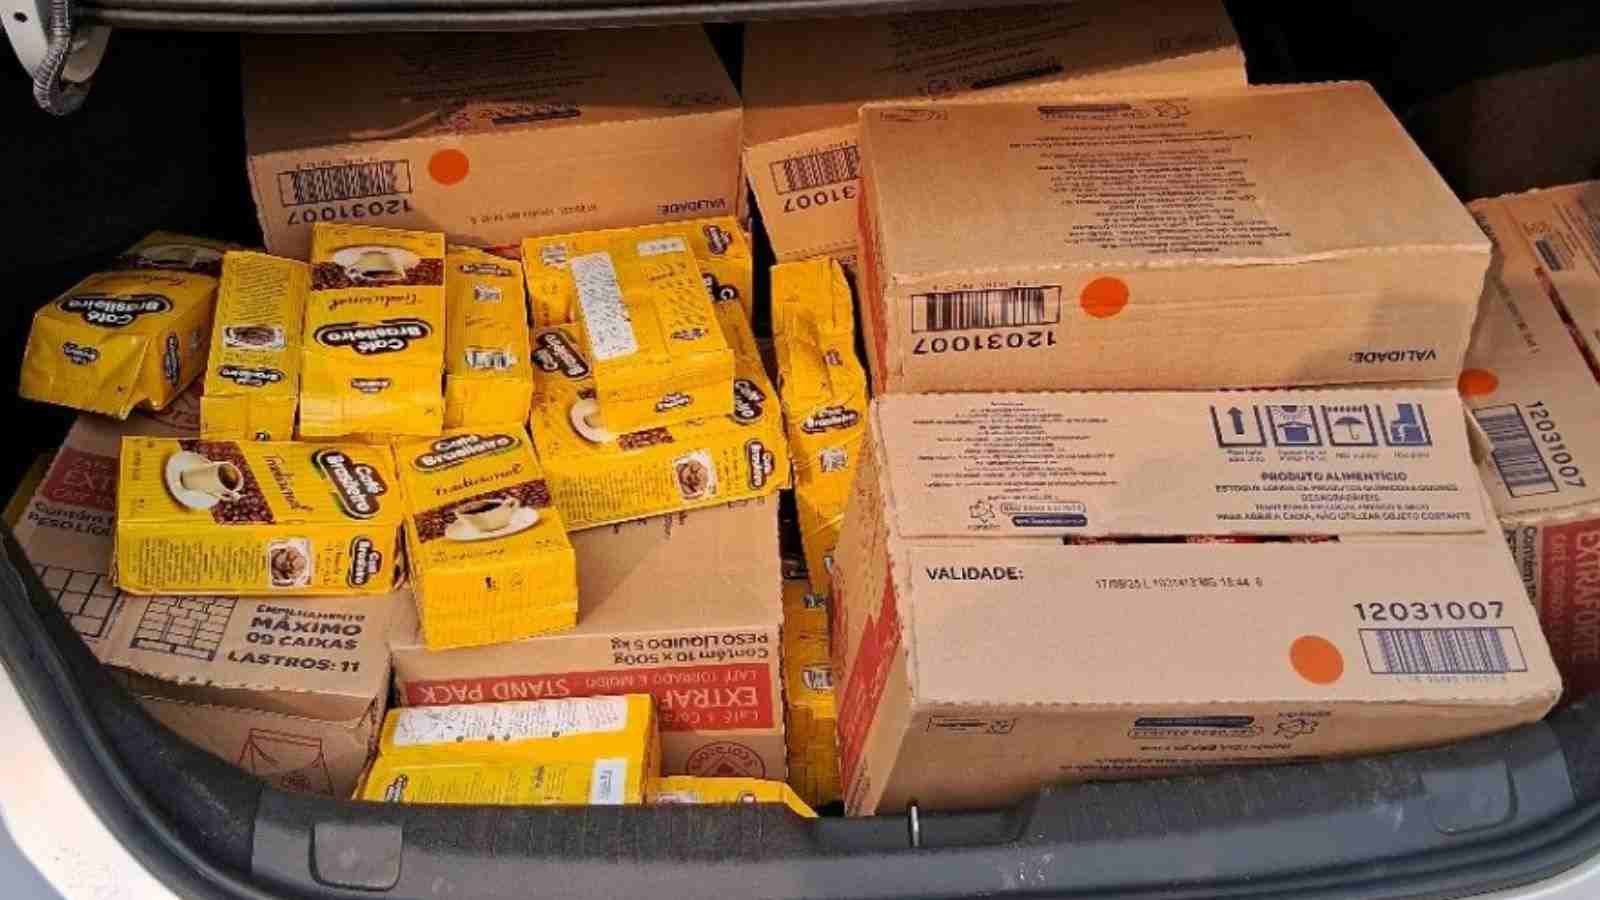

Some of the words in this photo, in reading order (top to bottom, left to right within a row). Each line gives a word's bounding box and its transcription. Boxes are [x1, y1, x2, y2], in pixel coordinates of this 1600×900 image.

[784, 186, 857, 213] 31007
[288, 200, 413, 224] 12031007
[87, 310, 133, 325] Café
[326, 325, 420, 342] Brasileiro
[356, 338, 405, 353] Café
[911, 331, 1058, 354] 12031007
[1346, 349, 1437, 364] VALIDADE:
[422, 437, 509, 466] Brasileiro
[1526, 401, 1586, 488] 12031007
[327, 454, 371, 513] Brasileiro
[355, 467, 384, 493] Café
[1262, 472, 1324, 481] PRODUTO
[927, 566, 1024, 581] VALIDADE:
[1354, 601, 1503, 621] 12031007
[250, 614, 362, 636] MÁXIMO
[247, 634, 273, 647] 09
[279, 636, 358, 650] CAIXAS
[611, 637, 631, 652] kg
[633, 637, 645, 650] 5
[648, 634, 719, 649] LÍQUIDO
[728, 633, 768, 647] PESO
[228, 651, 337, 672] LASTROS:
[342, 661, 360, 673] 11
[613, 650, 659, 665] 500g
[675, 650, 695, 663] 10
[698, 646, 768, 662] Contém
[653, 670, 718, 685] TORRADO
[417, 684, 483, 706] PACK
[494, 677, 569, 701] STAND
[661, 686, 758, 709] EXTRAF
